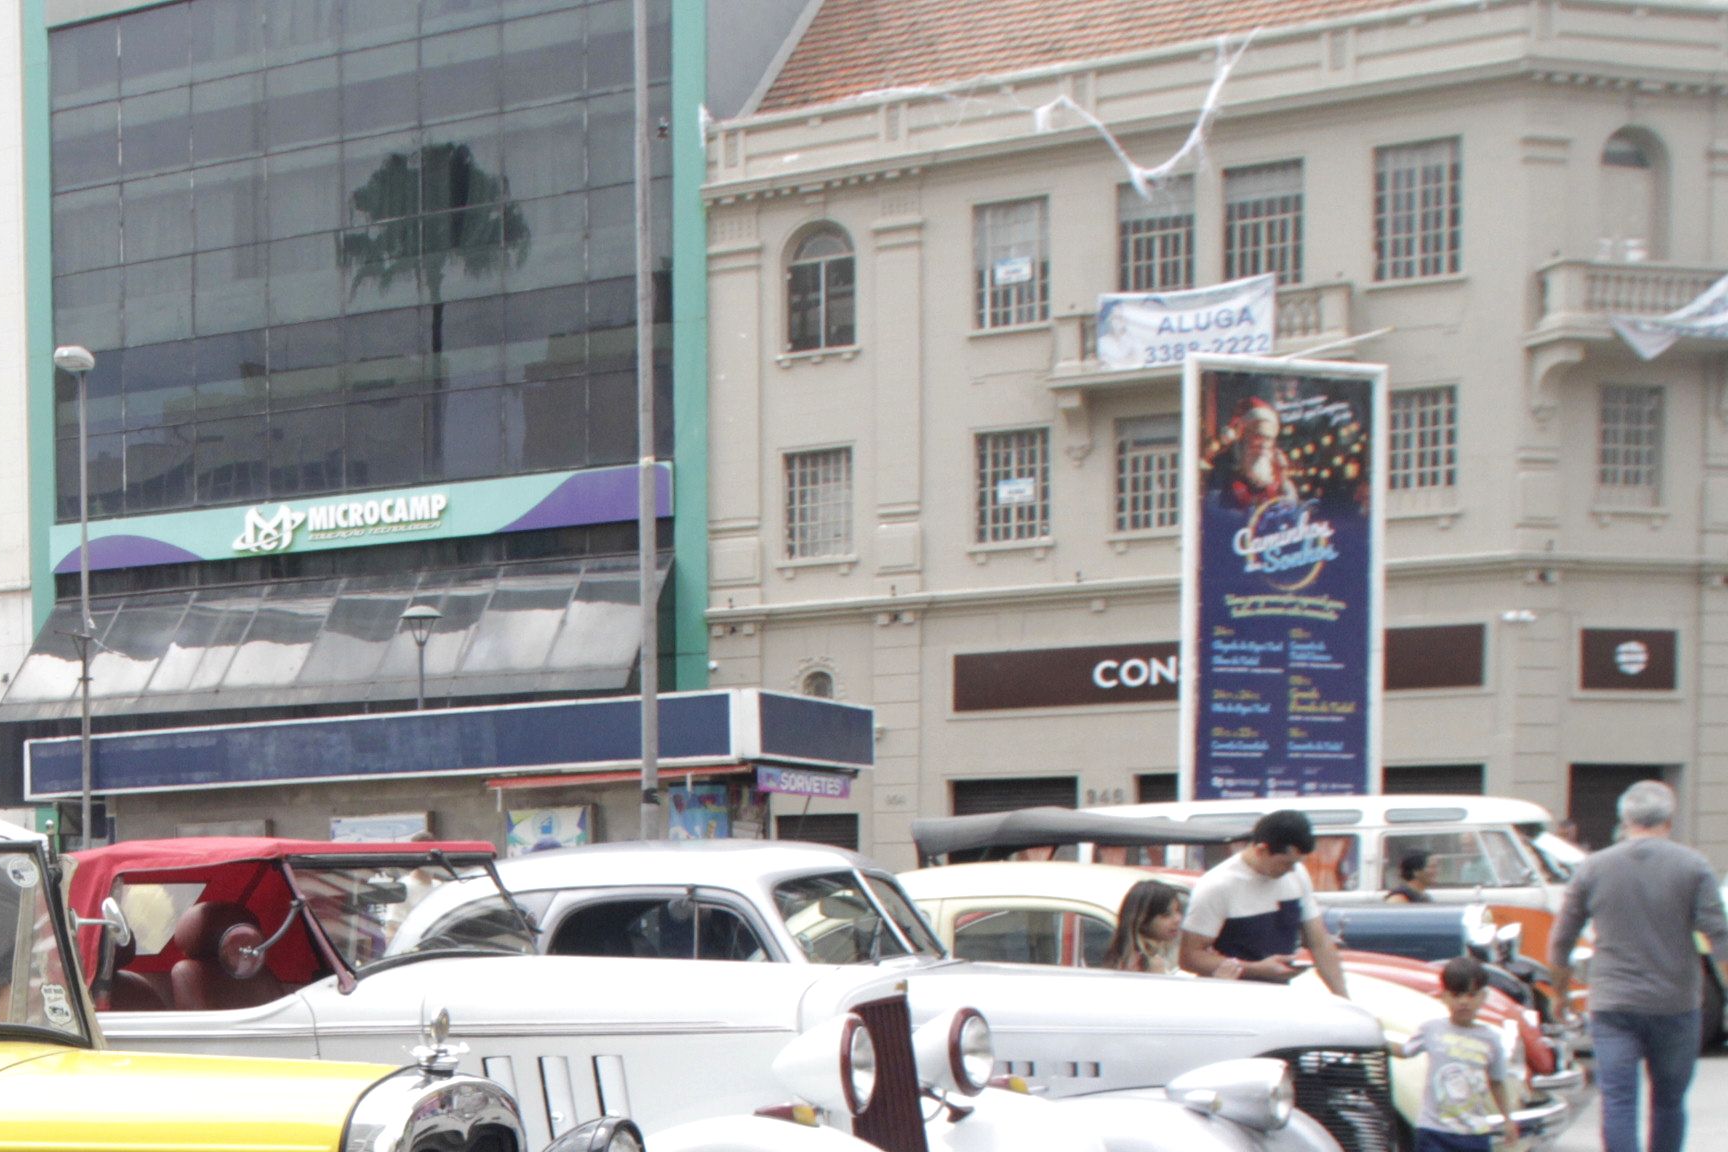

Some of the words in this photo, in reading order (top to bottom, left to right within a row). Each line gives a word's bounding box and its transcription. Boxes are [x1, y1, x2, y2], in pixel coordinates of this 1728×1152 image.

[1157, 304, 1256, 334] ALUGA
[308, 495, 447, 533] MICROCAMP
[1233, 510, 1336, 556] Caminhos
[1262, 535, 1340, 574] Sonhos
[1092, 655, 1180, 688] CON
[780, 772, 843, 795] SORVETES
